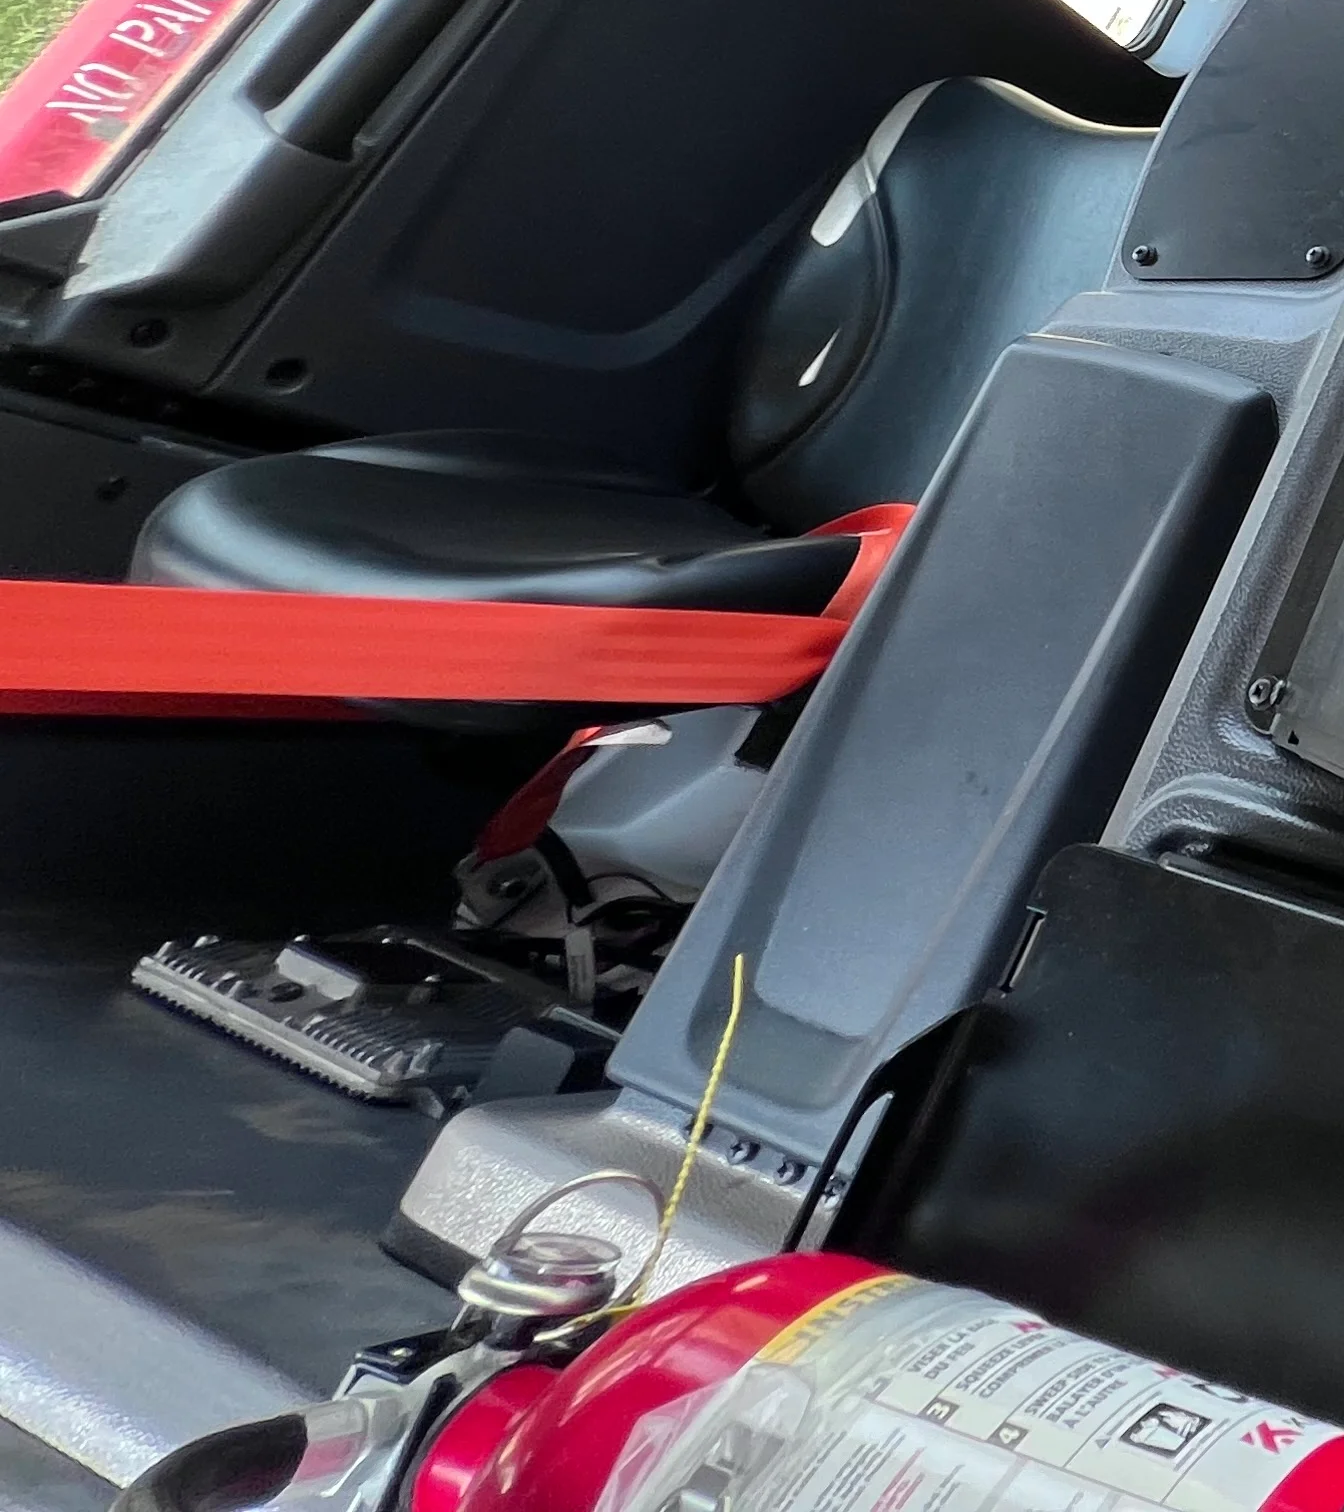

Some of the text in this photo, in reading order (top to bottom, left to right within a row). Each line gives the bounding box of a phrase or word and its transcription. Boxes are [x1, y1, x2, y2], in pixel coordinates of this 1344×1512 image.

[46, 62, 138, 123] NO
[907, 1343, 948, 1373] VISER
[923, 1362, 950, 1380] DU
[956, 1347, 1013, 1392] SQUEEZE
[926, 1401, 950, 1420] 3
[1024, 1375, 1069, 1416] SWEEP
[1046, 1372, 1106, 1423] BALAYER
[998, 1425, 1021, 1445] 4
